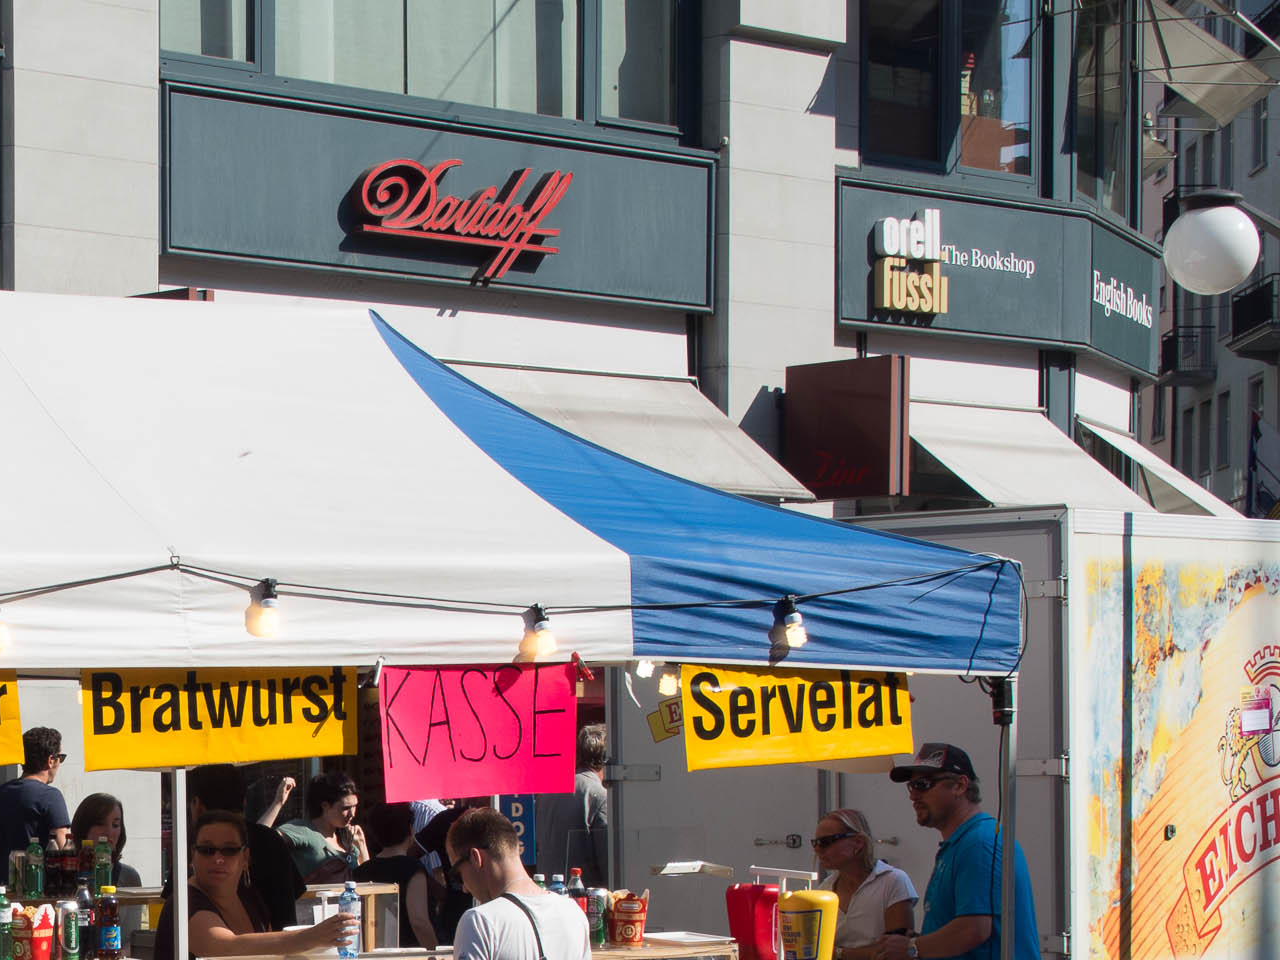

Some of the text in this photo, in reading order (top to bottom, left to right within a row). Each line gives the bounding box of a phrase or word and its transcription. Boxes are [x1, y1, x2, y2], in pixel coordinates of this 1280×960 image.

[361, 158, 573, 279] Davidoff
[883, 208, 941, 260] orell
[883, 251, 949, 314] füssli
[942, 244, 1035, 279] The Bookshop
[1093, 269, 1153, 329] English Books
[91, 667, 348, 736] Bratwurst
[382, 663, 567, 769] KASSE
[690, 670, 903, 741] Servelat
